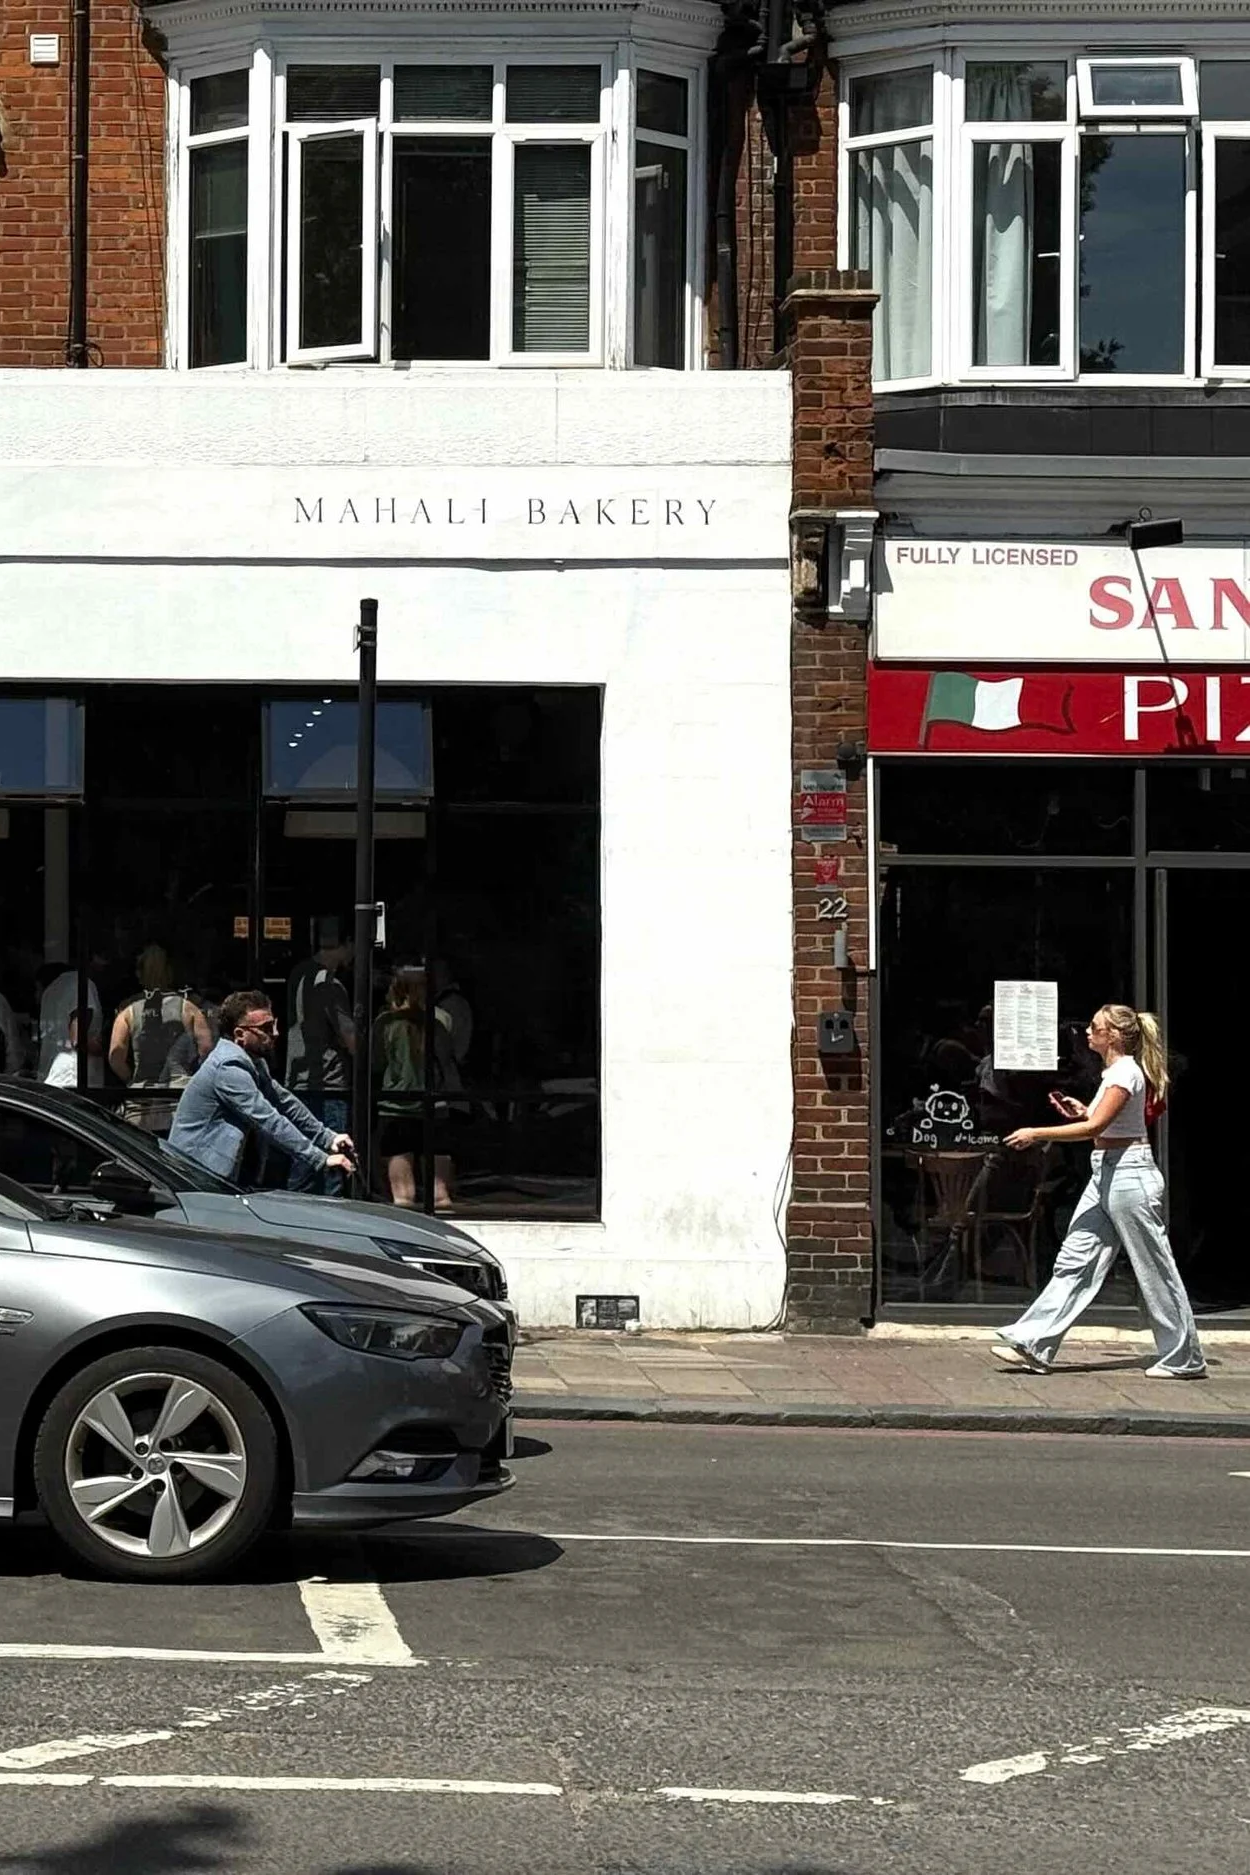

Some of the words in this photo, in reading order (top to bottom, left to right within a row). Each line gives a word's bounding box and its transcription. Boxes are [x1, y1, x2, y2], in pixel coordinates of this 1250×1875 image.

[294, 497, 486, 524] MAHALI
[528, 498, 716, 525] BAKERY
[897, 547, 961, 564] FULLY
[972, 548, 1078, 566] LICENSED
[803, 795, 844, 807] Alarm
[819, 897, 848, 919] 22
[912, 1127, 938, 1149] Dog
